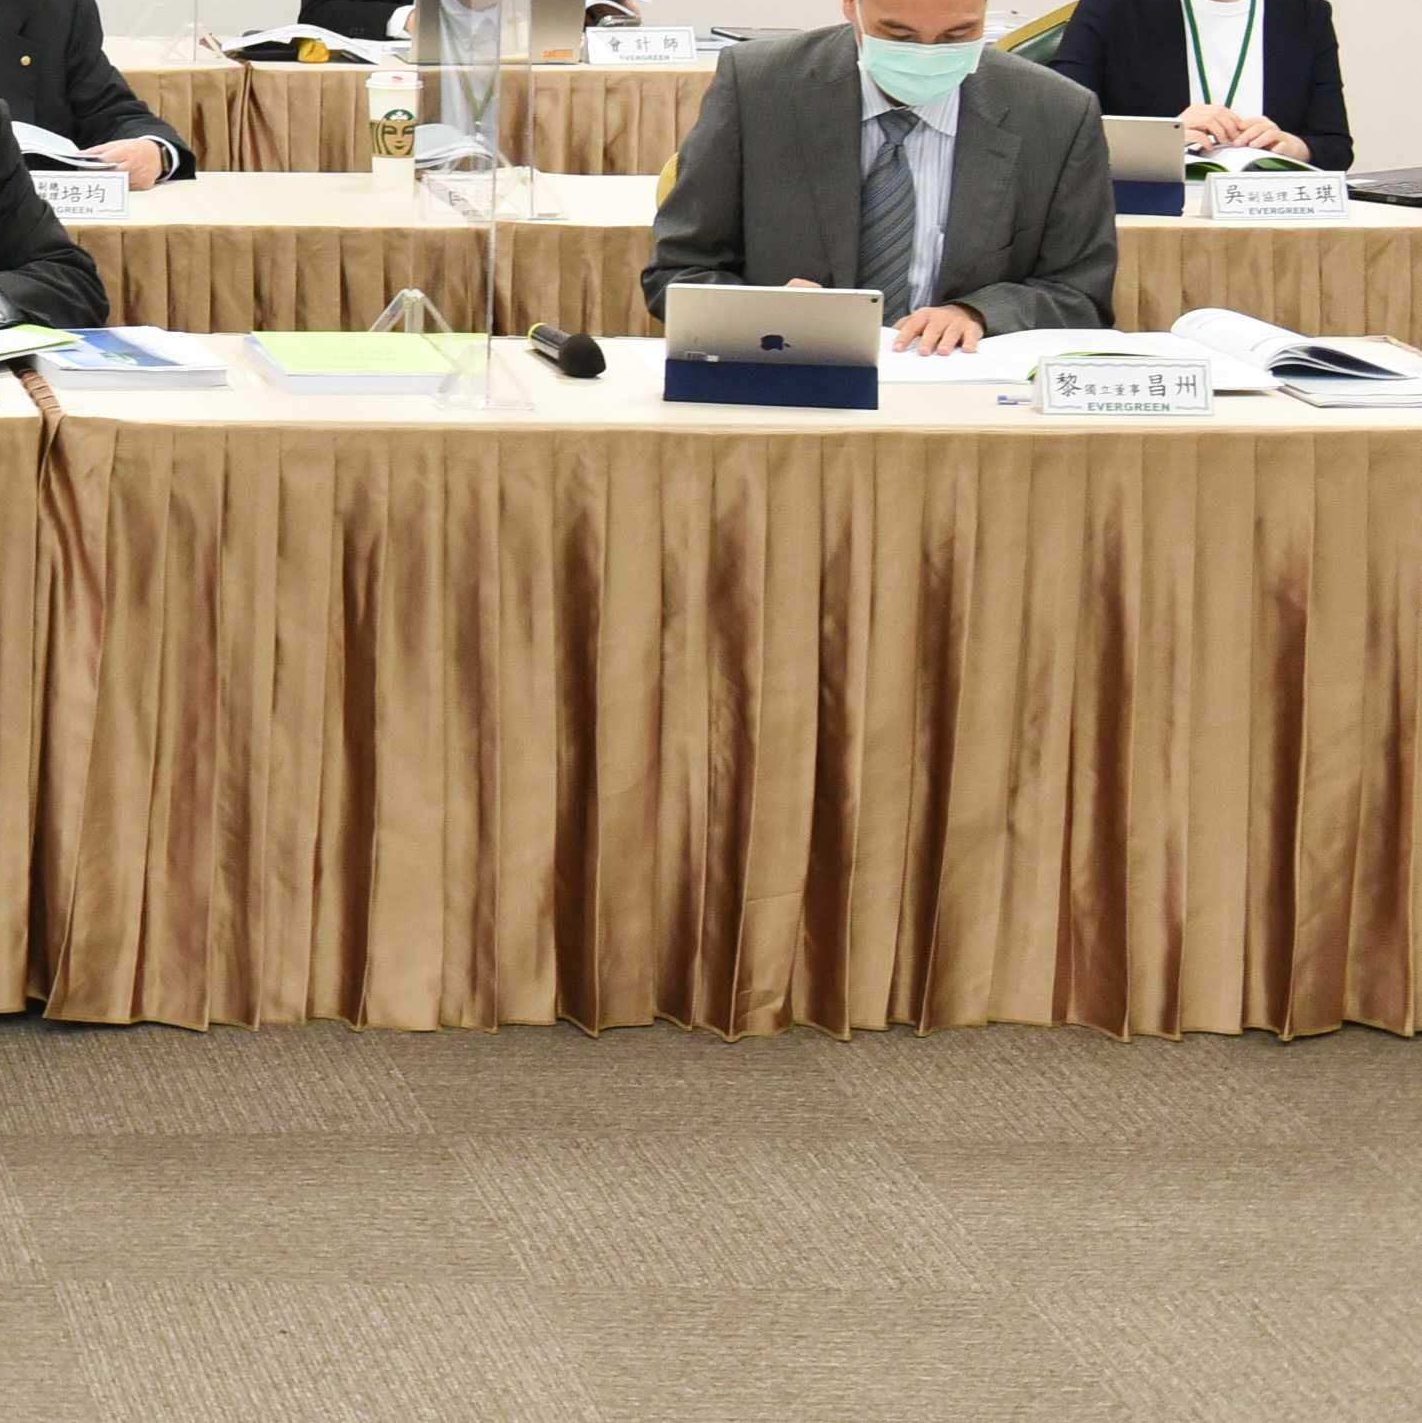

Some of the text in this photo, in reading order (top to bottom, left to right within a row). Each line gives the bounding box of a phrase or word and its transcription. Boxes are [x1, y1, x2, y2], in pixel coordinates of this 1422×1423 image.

[609, 36, 678, 52] 會計師
[55, 206, 94, 214] GREEN
[1249, 207, 1315, 215] EVERGREEN
[1087, 402, 1170, 412] EVERGREEN
